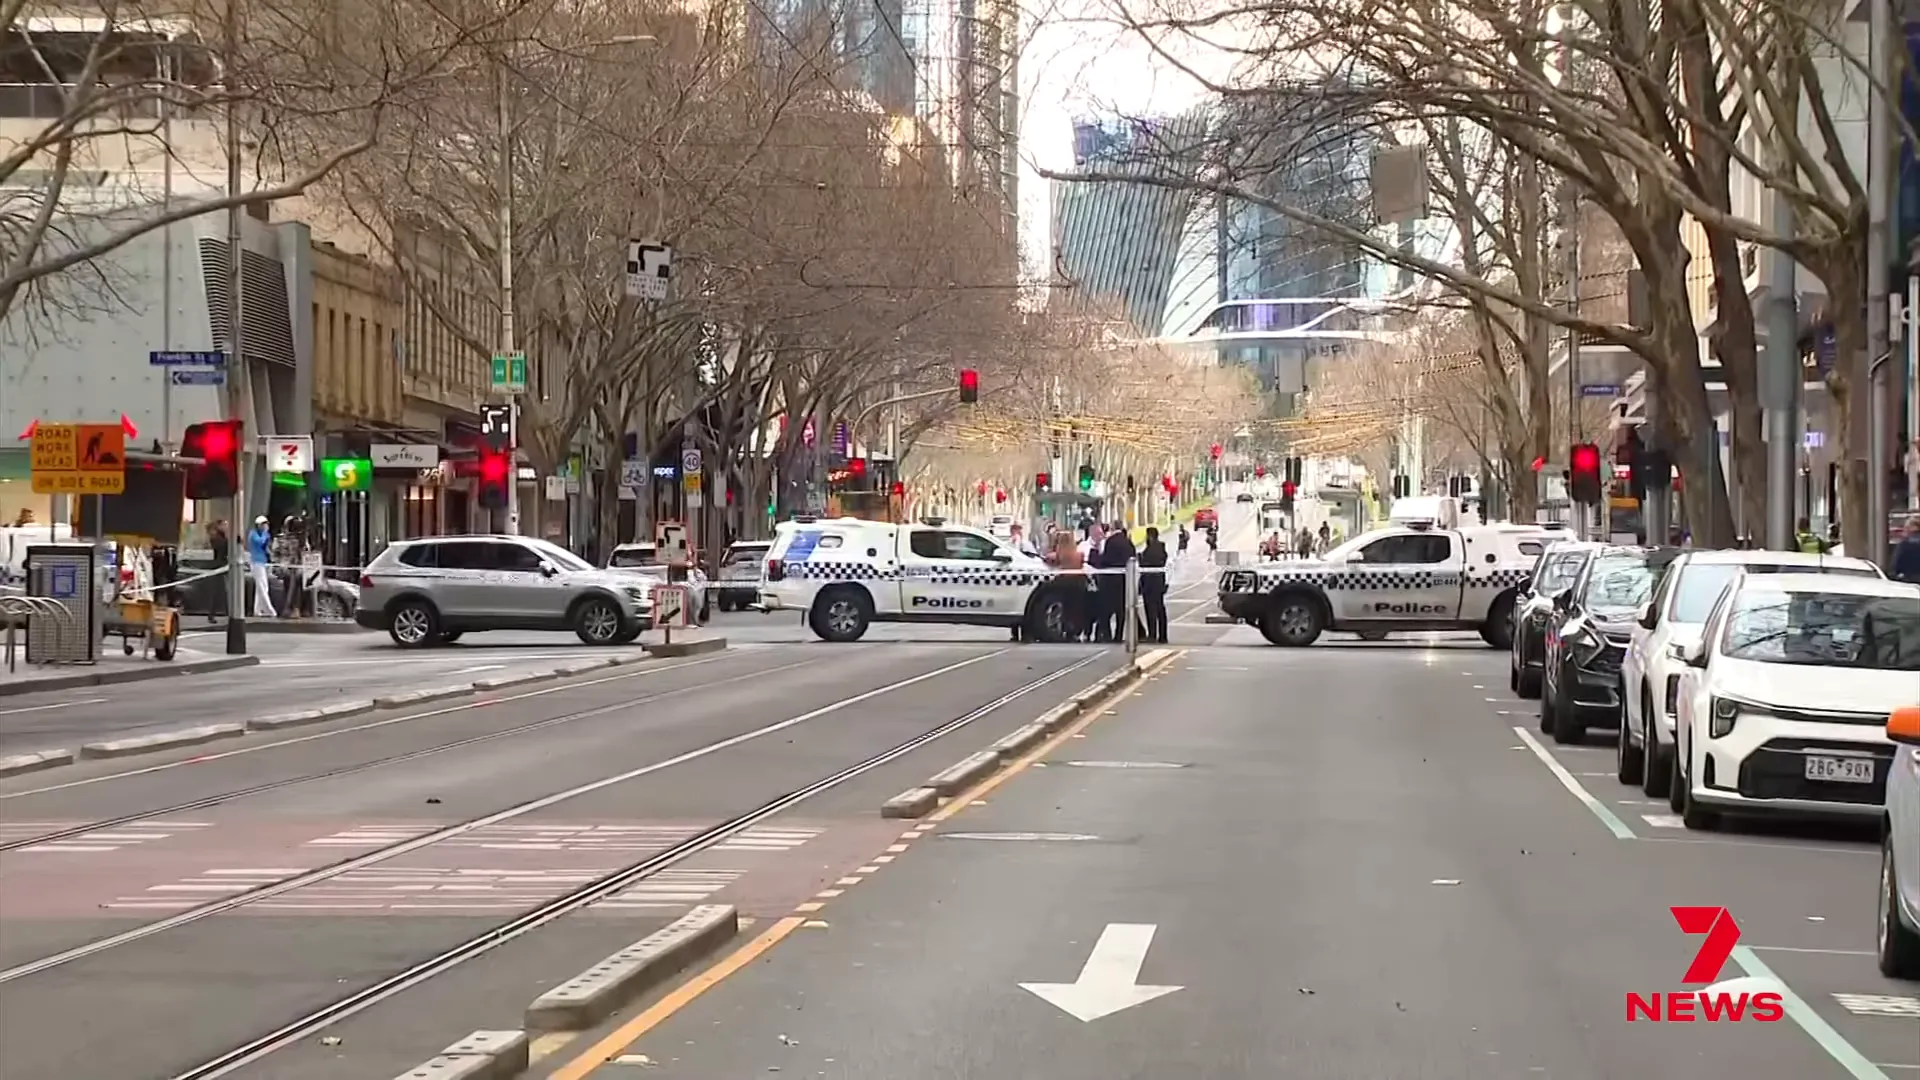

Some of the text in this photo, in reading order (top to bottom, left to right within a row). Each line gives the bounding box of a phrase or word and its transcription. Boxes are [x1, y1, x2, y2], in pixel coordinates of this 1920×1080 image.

[36, 428, 71, 439] ROAD
[36, 443, 71, 453] WORK
[36, 456, 73, 467] AHEAD
[686, 457, 699, 467] 40
[60, 477, 85, 488] SIDE
[90, 478, 120, 488] ROAD
[912, 596, 982, 608] Police
[1375, 602, 1447, 613] Police
